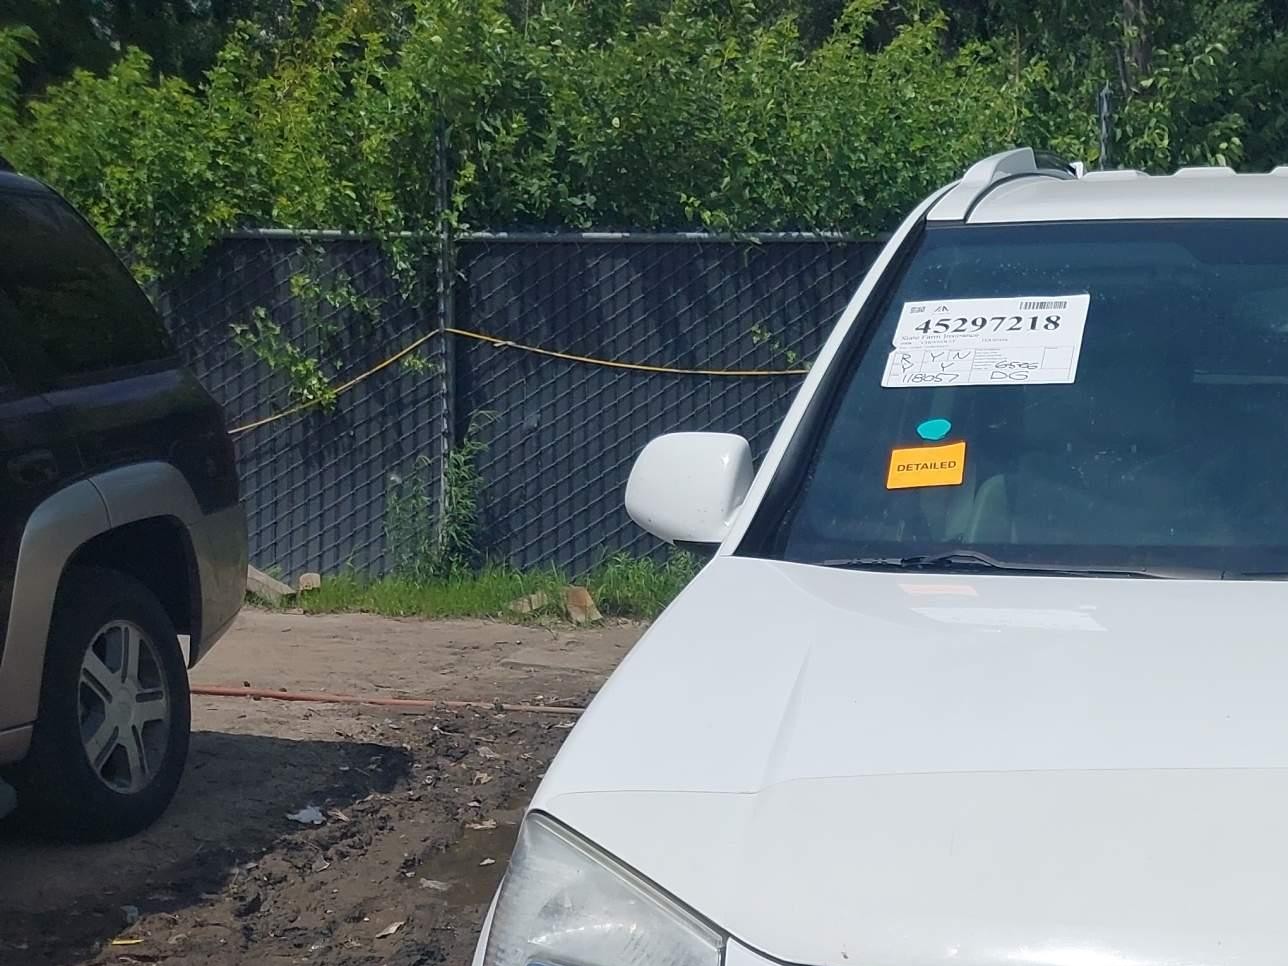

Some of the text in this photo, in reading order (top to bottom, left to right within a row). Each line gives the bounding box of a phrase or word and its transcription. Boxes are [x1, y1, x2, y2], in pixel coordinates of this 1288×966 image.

[914, 315, 1061, 334] 45297218
[930, 351, 945, 362] Y
[897, 460, 957, 472] DETAILED
